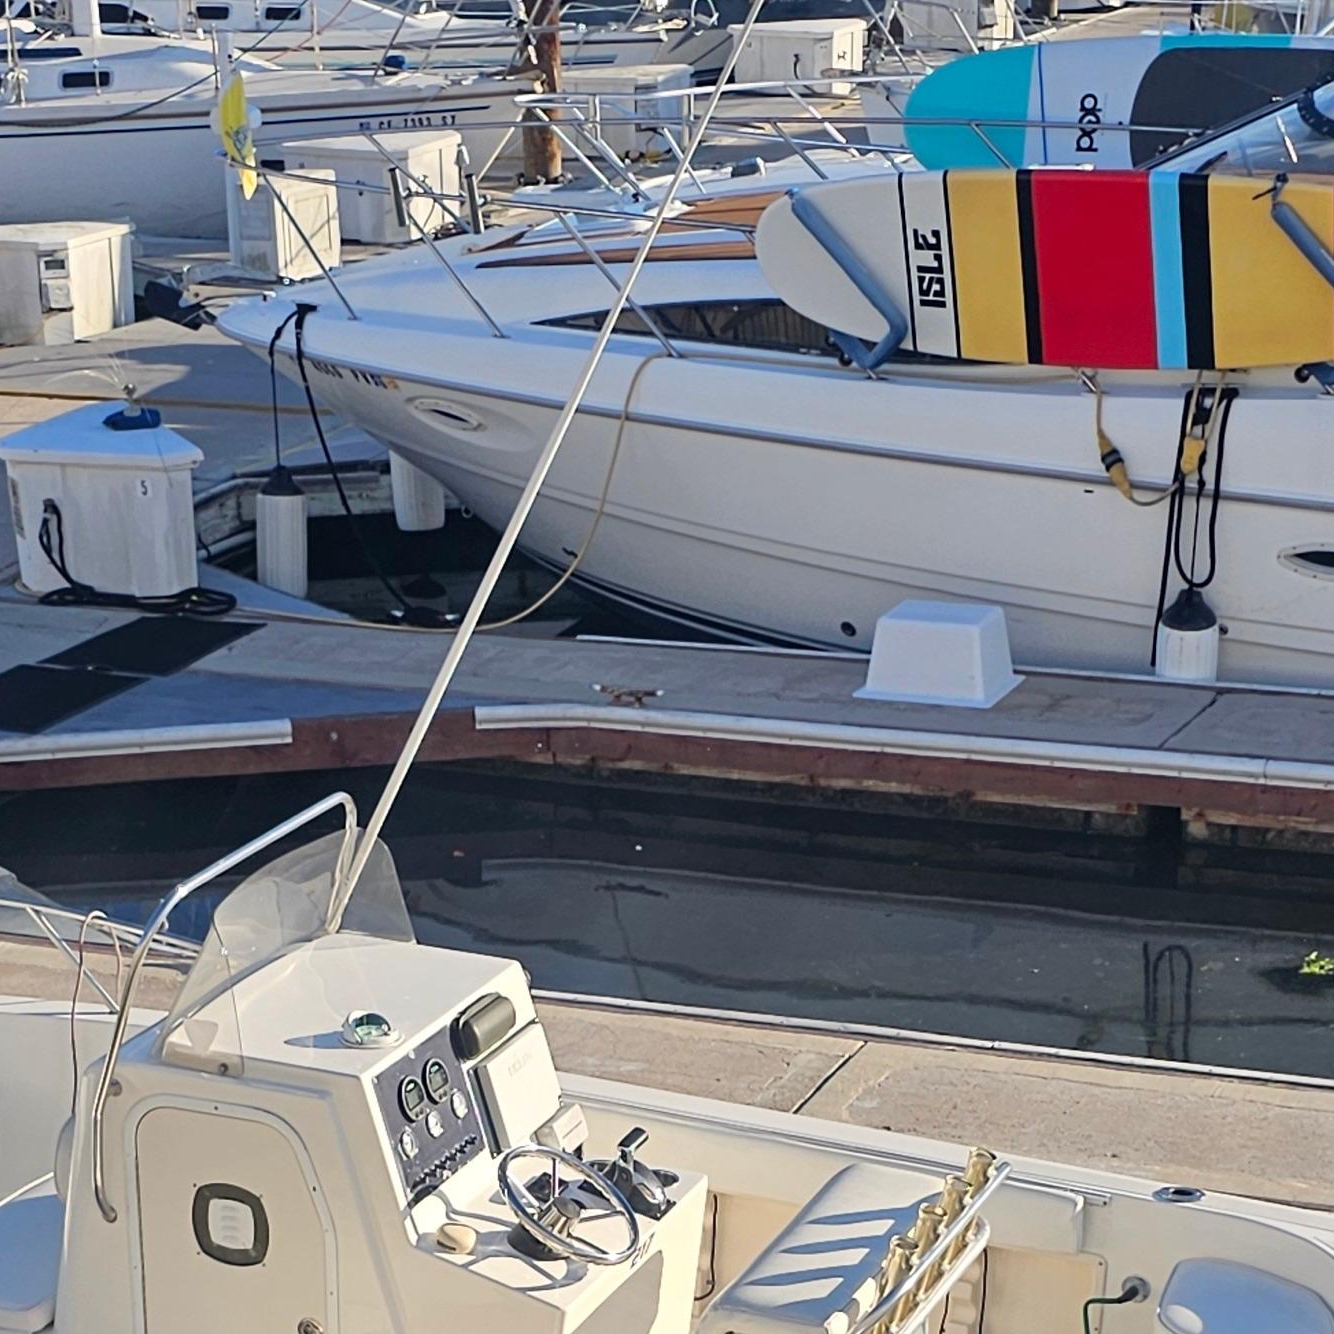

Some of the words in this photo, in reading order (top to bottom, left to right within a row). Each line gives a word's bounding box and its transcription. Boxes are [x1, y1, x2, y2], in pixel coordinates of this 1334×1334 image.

[1075, 93, 1103, 152] pop
[912, 228, 947, 308] ISLE
[140, 479, 149, 496] 5
